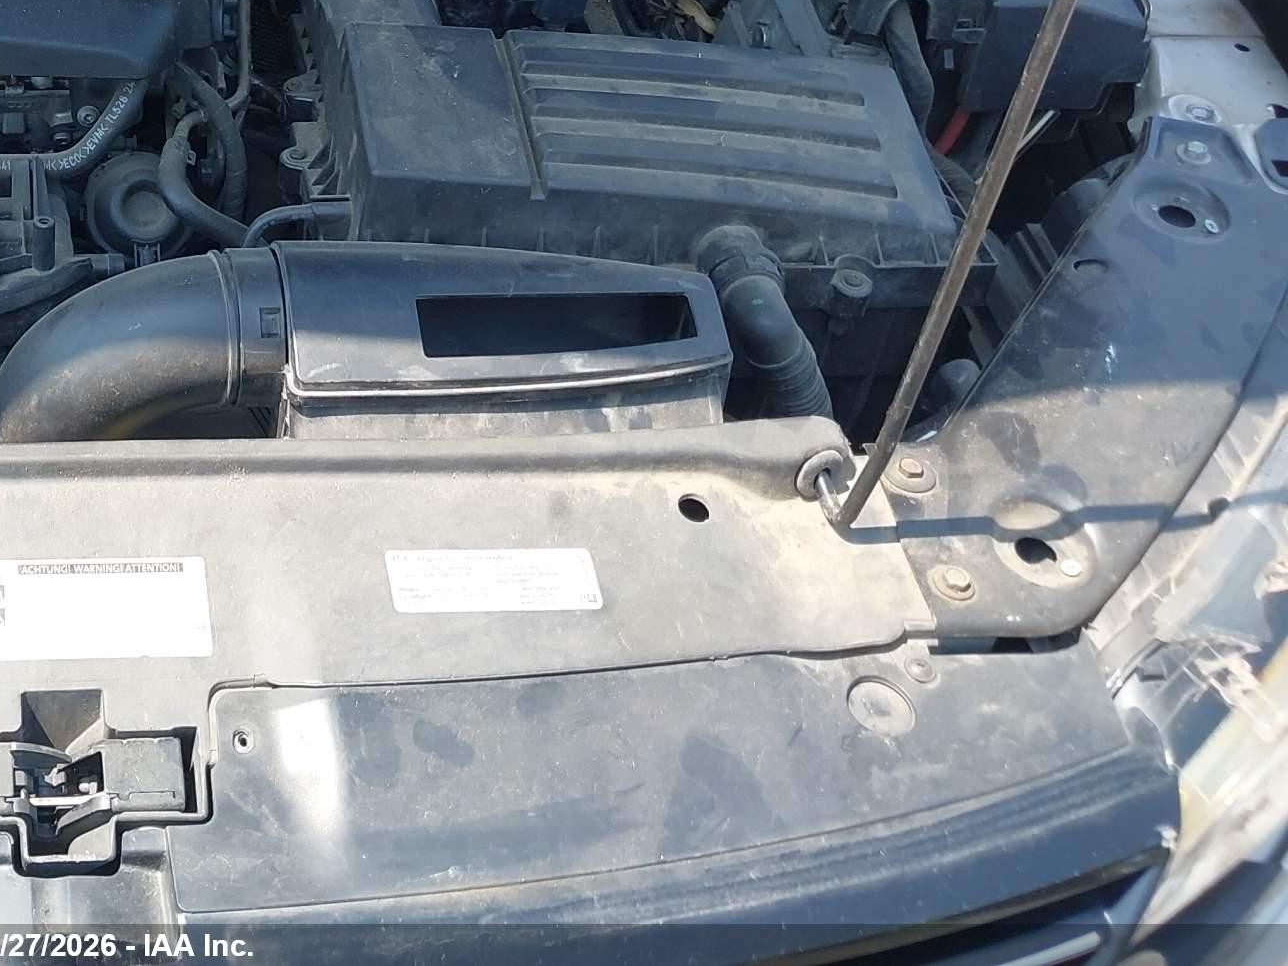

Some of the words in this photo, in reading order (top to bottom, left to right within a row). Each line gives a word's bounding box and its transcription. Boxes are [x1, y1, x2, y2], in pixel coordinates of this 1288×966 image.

[21, 564, 70, 575] ACHTUNG!
[72, 563, 123, 574] WARNING!
[123, 562, 180, 574] ATTENTION!
